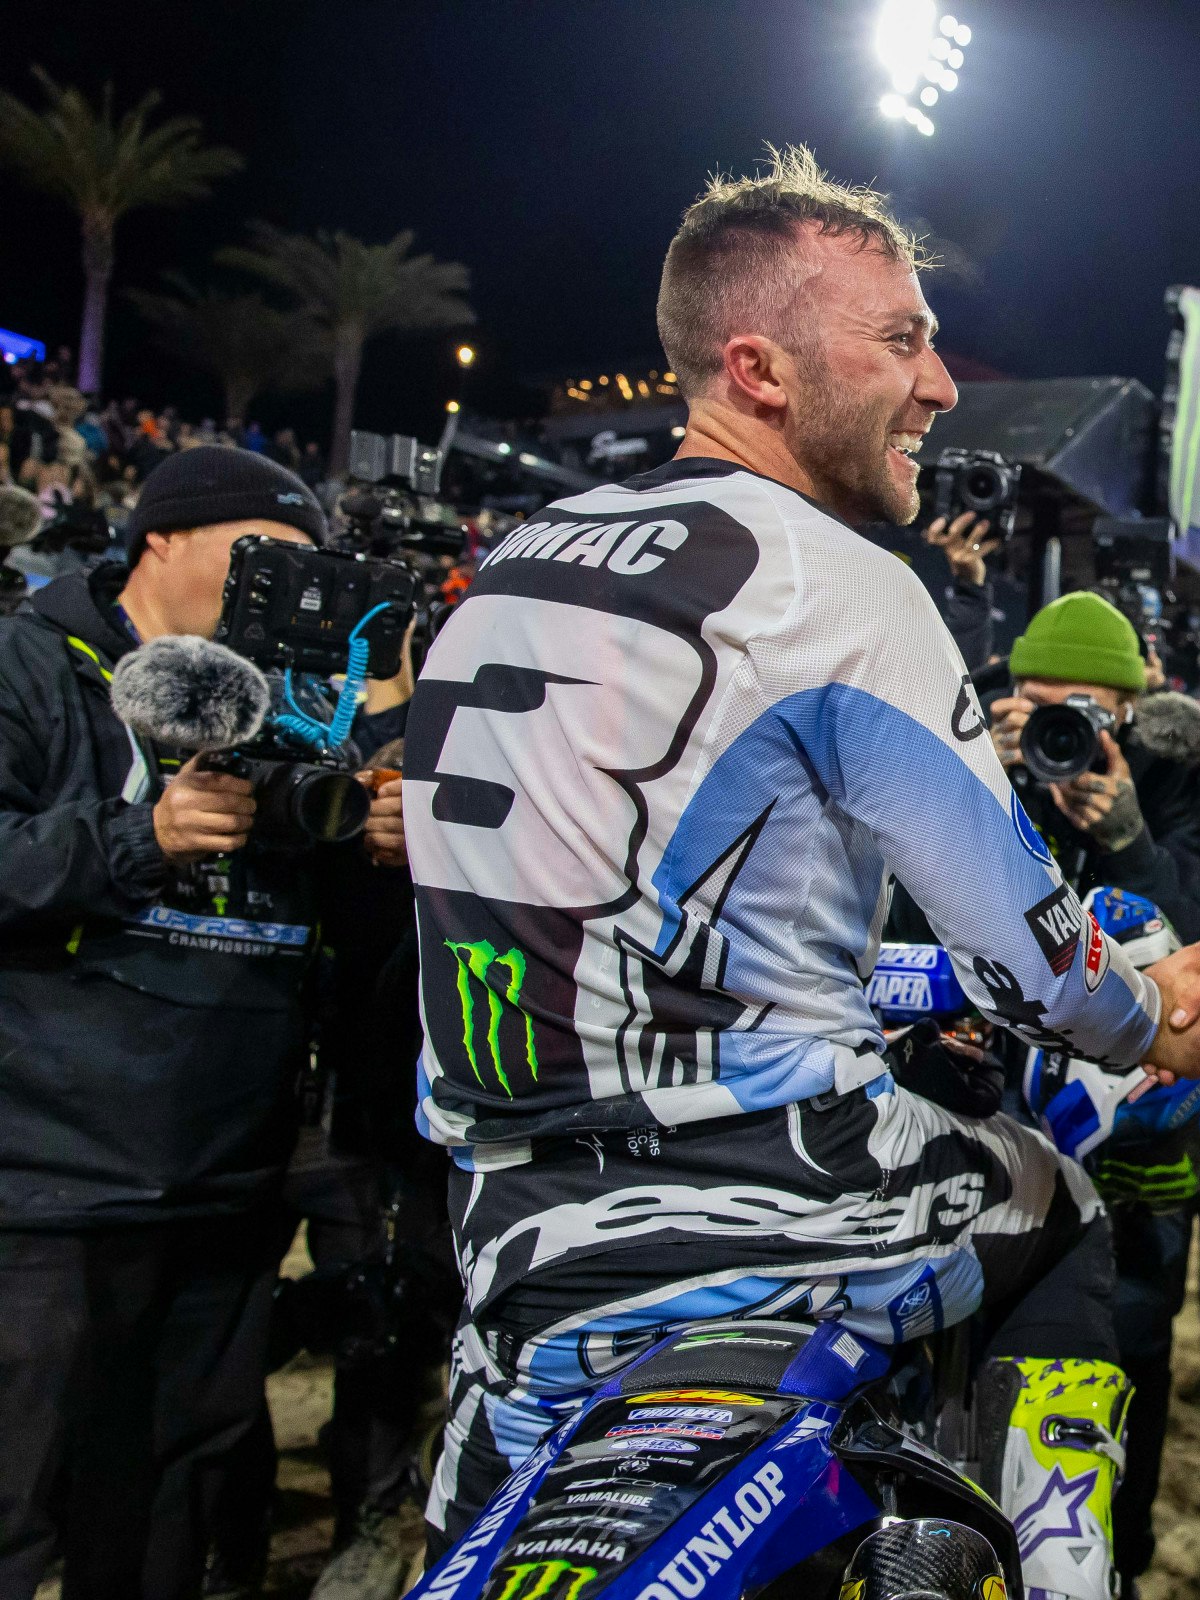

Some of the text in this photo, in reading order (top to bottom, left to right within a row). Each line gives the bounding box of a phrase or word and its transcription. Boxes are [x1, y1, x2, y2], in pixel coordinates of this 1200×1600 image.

[402, 593, 704, 909] 3
[566, 1491, 653, 1508] YAMALUBE
[514, 1537, 627, 1562] YAMAHA
